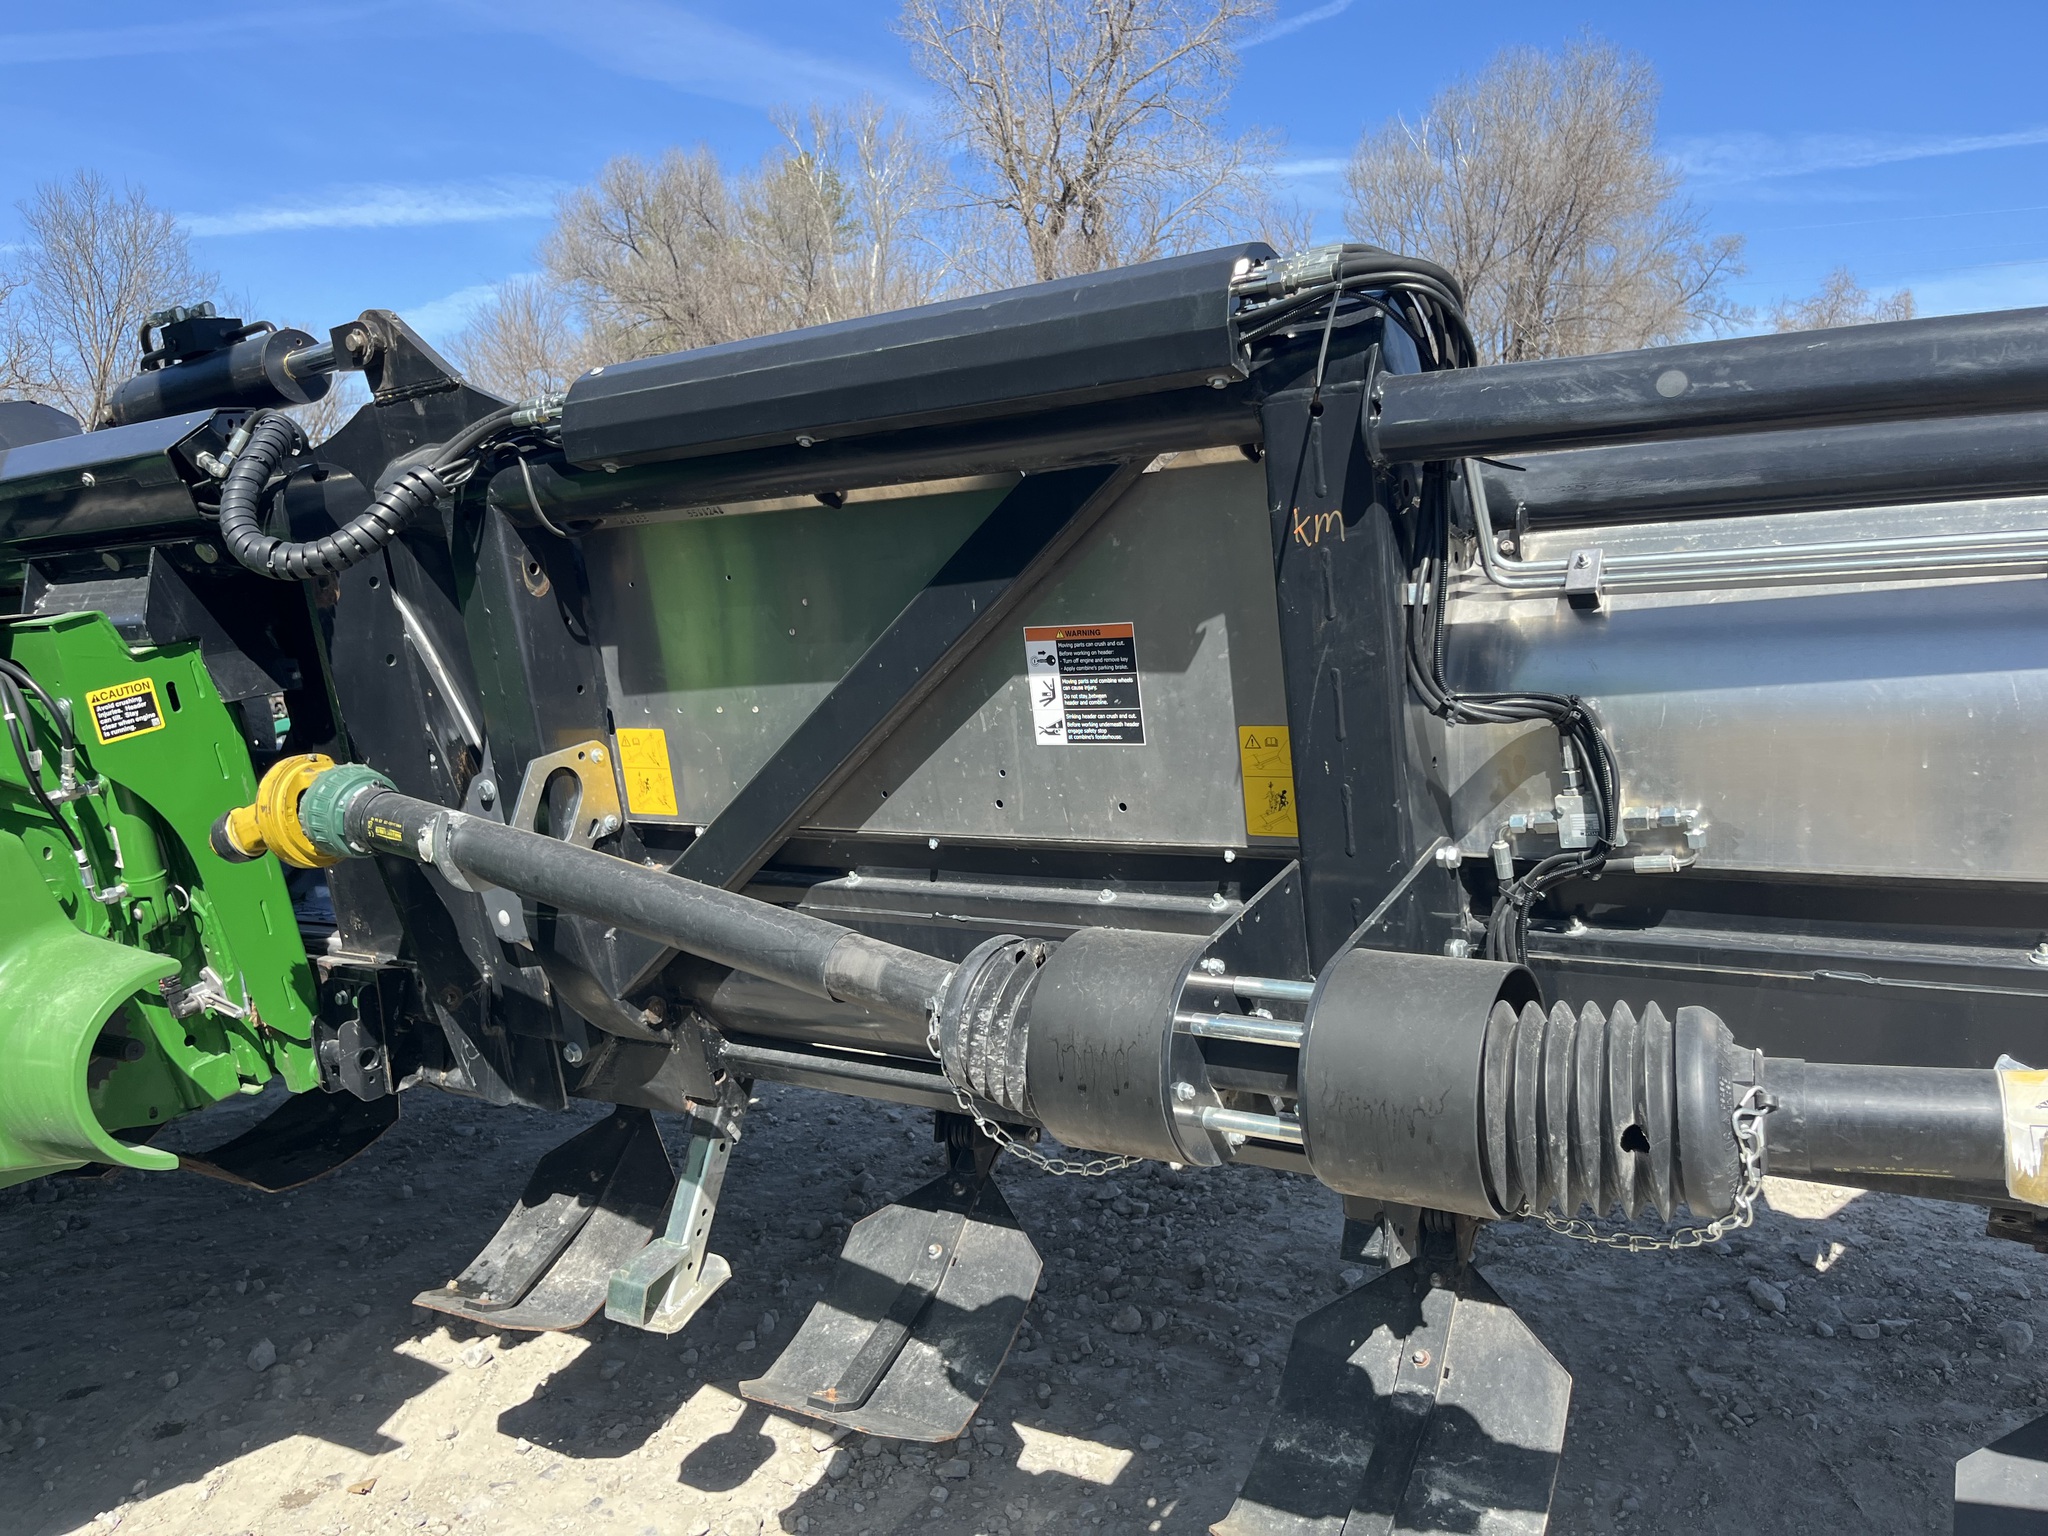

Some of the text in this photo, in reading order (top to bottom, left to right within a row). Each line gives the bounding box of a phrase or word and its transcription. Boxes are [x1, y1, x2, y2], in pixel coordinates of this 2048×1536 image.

[100, 681, 150, 700] CAUTION
[96, 696, 142, 712] Avoid crushing
[125, 701, 147, 711] Header
[101, 712, 156, 731] clear when engine
[124, 710, 139, 719] Stay
